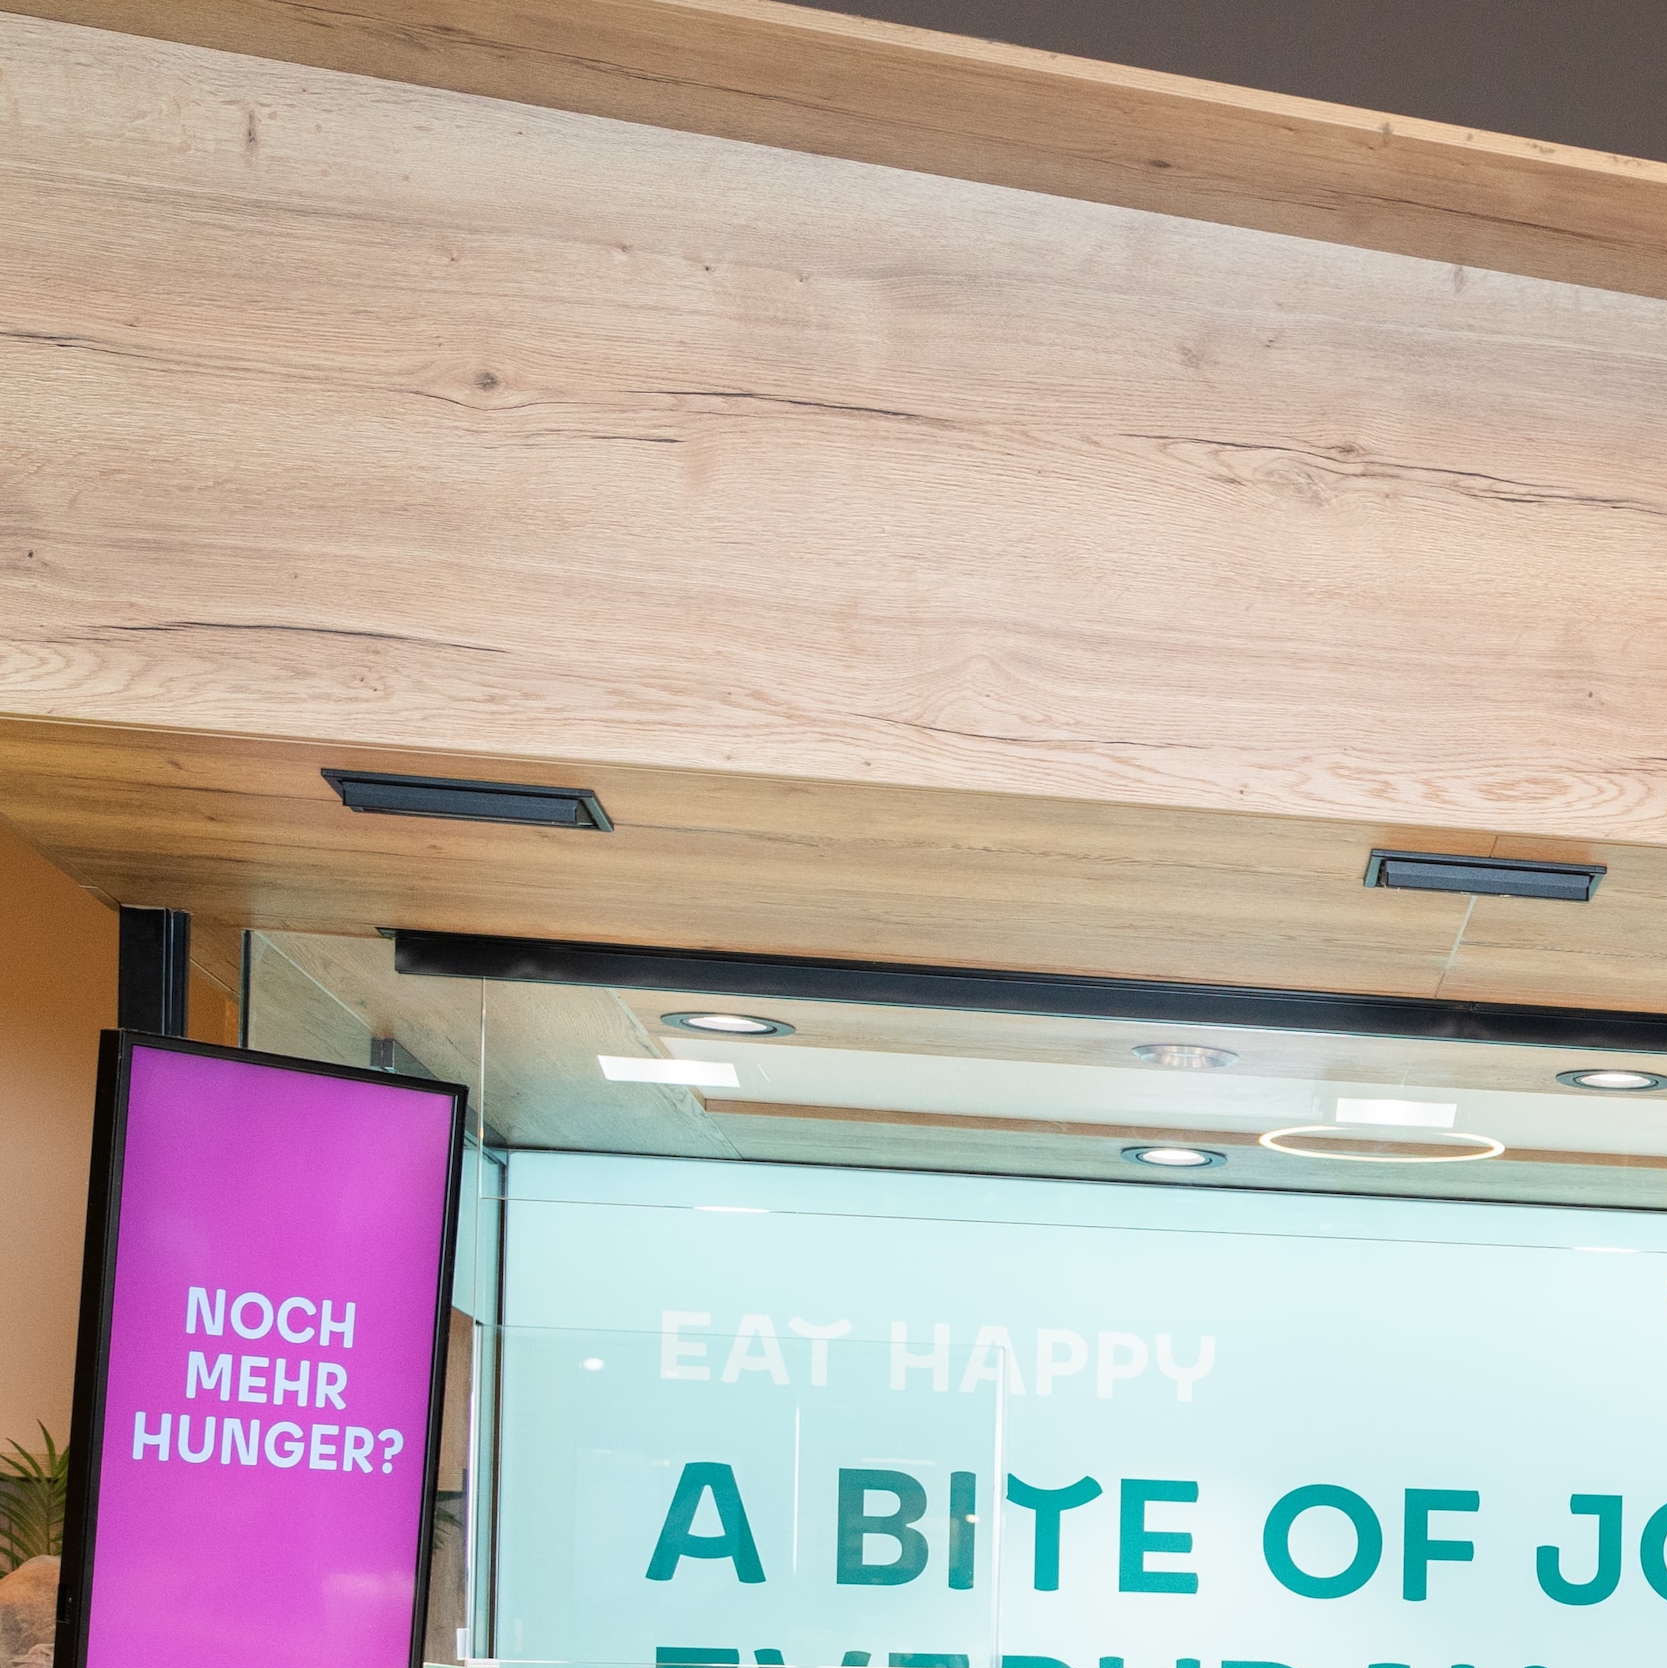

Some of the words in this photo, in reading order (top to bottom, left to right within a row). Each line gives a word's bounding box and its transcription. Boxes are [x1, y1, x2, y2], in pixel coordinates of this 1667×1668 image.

[185, 1286, 357, 1349] NOCH
[185, 1350, 349, 1410] MEHR
[658, 1309, 851, 1385] EAT
[888, 1320, 1217, 1401] HAPPY
[131, 1410, 405, 1474] HUNGER?
[644, 1460, 767, 1584] A
[835, 1466, 1201, 1595] BITE
[1262, 1483, 1481, 1602] OF
